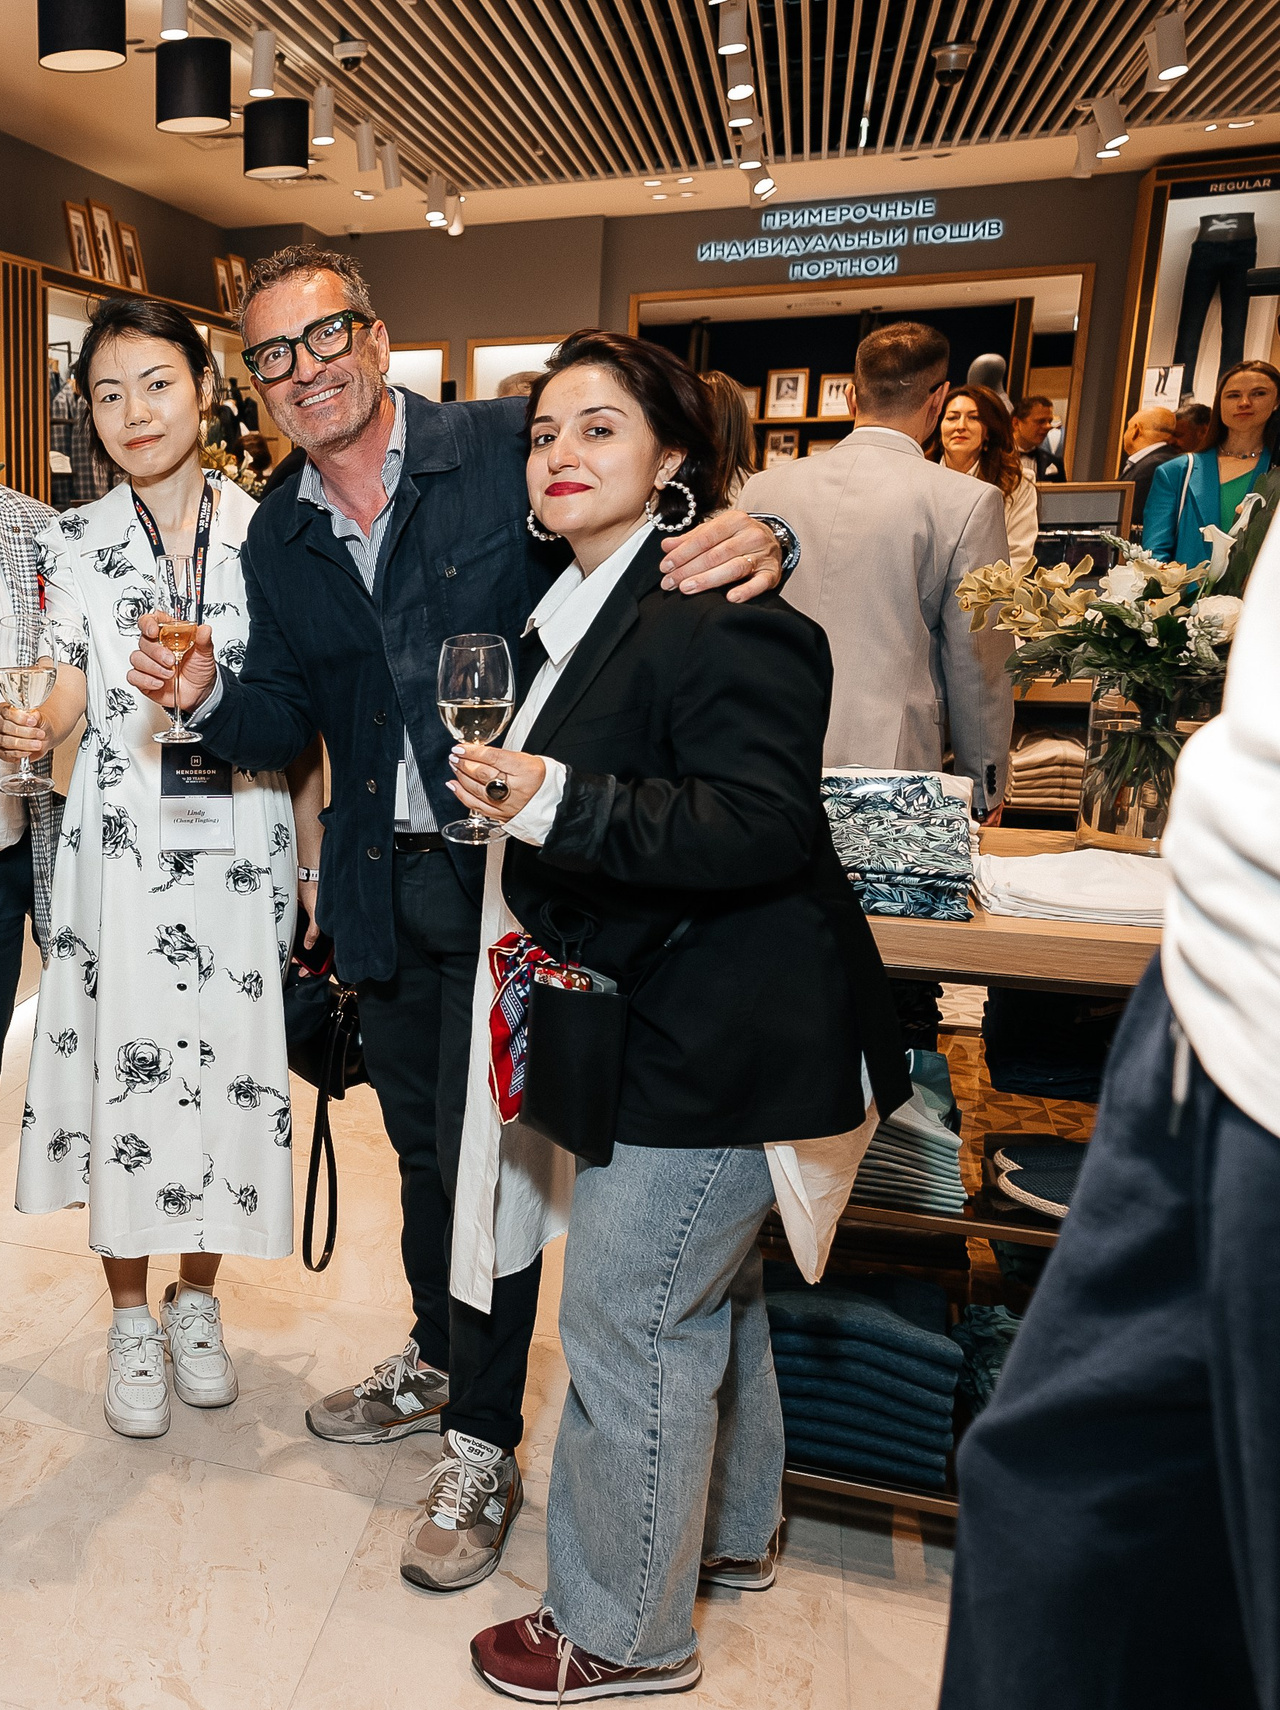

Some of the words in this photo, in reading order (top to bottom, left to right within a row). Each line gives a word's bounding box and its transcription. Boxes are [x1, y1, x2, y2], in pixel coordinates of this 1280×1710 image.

[1209, 178, 1272, 193] REGULAR
[762, 198, 936, 230] ПРИМЕРОЧНЫЕ
[697, 224, 908, 261] ИНДИВИДУАЛЬНЫЙ
[913, 219, 1004, 245] ПОШИВ
[789, 253, 899, 281] ПОРТНОЙ
[459, 1436, 471, 1445] new
[466, 1446, 485, 1458] 991
